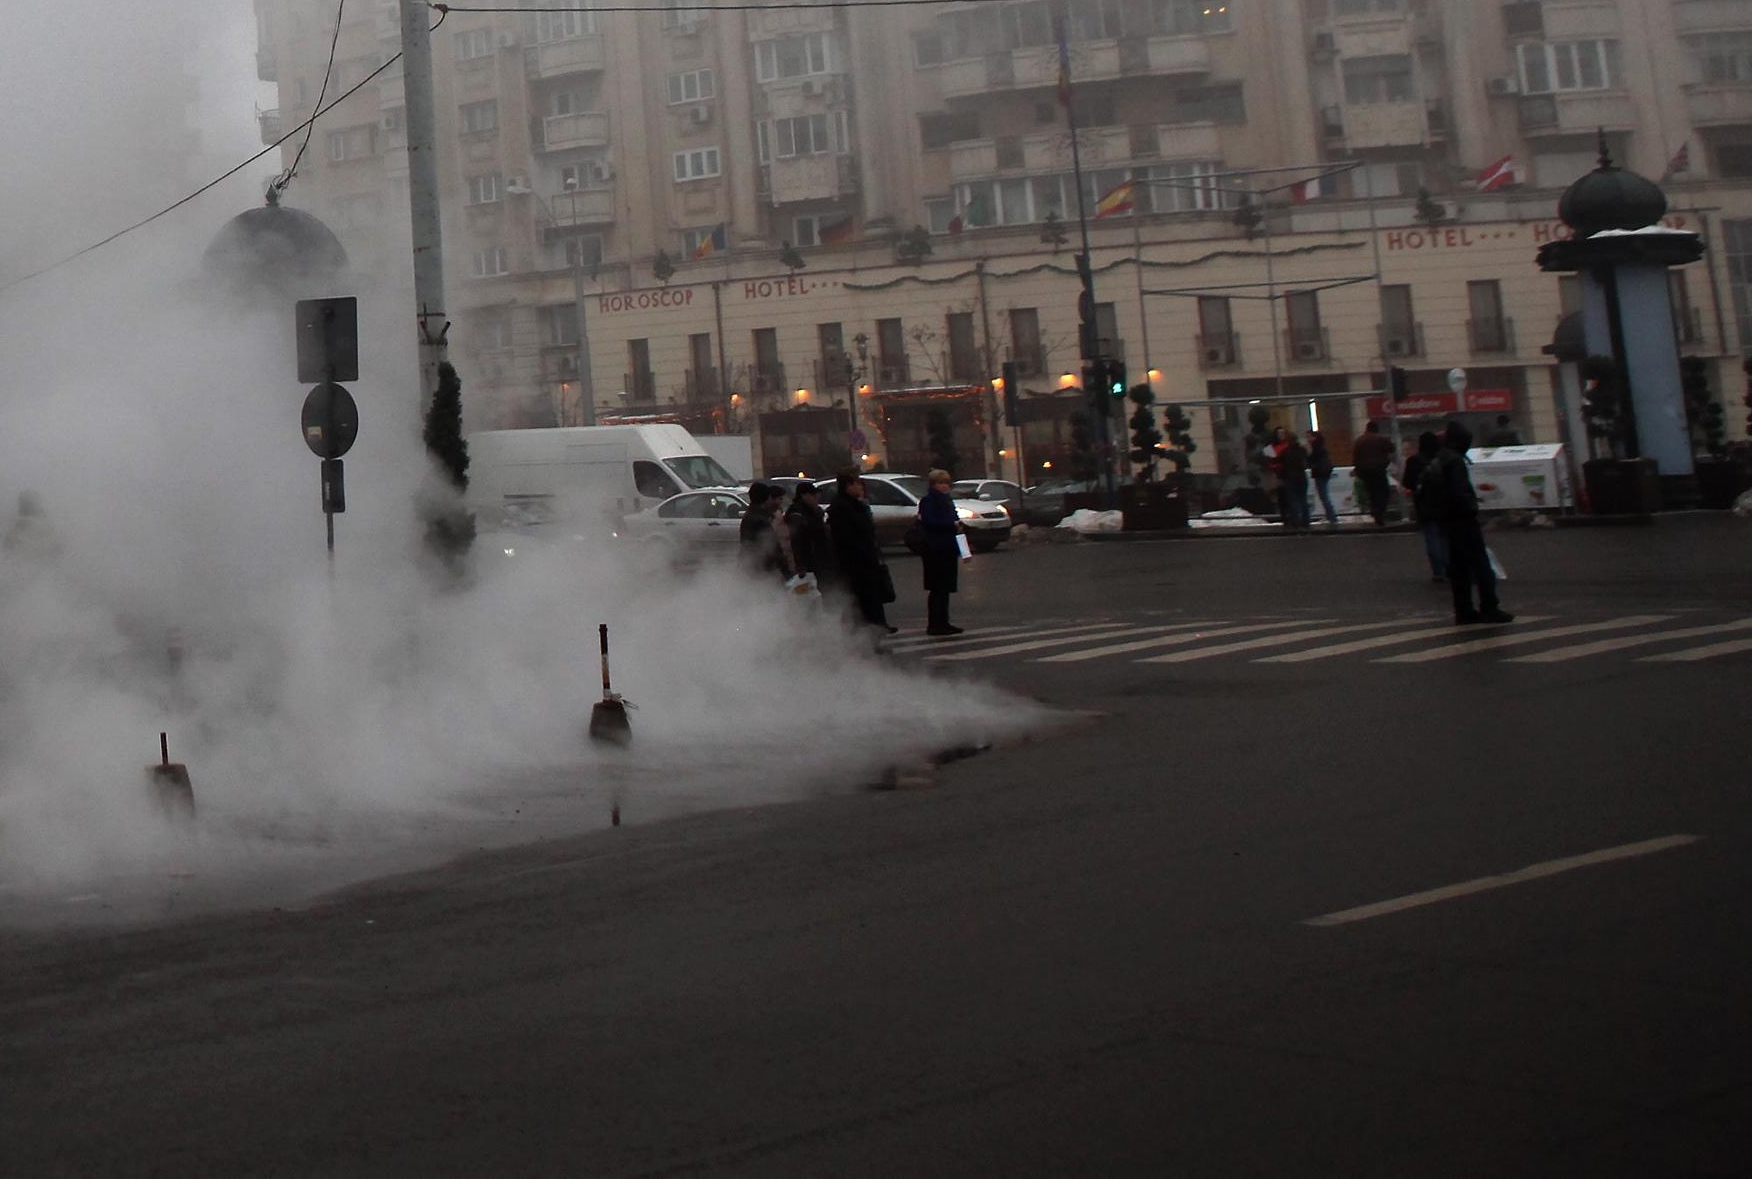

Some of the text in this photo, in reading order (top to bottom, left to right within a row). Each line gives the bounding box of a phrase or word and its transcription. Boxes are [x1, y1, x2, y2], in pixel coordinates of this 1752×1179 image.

[1387, 226, 1473, 251] HOTEL
[599, 278, 811, 313] HOROSCOP HOTEL
